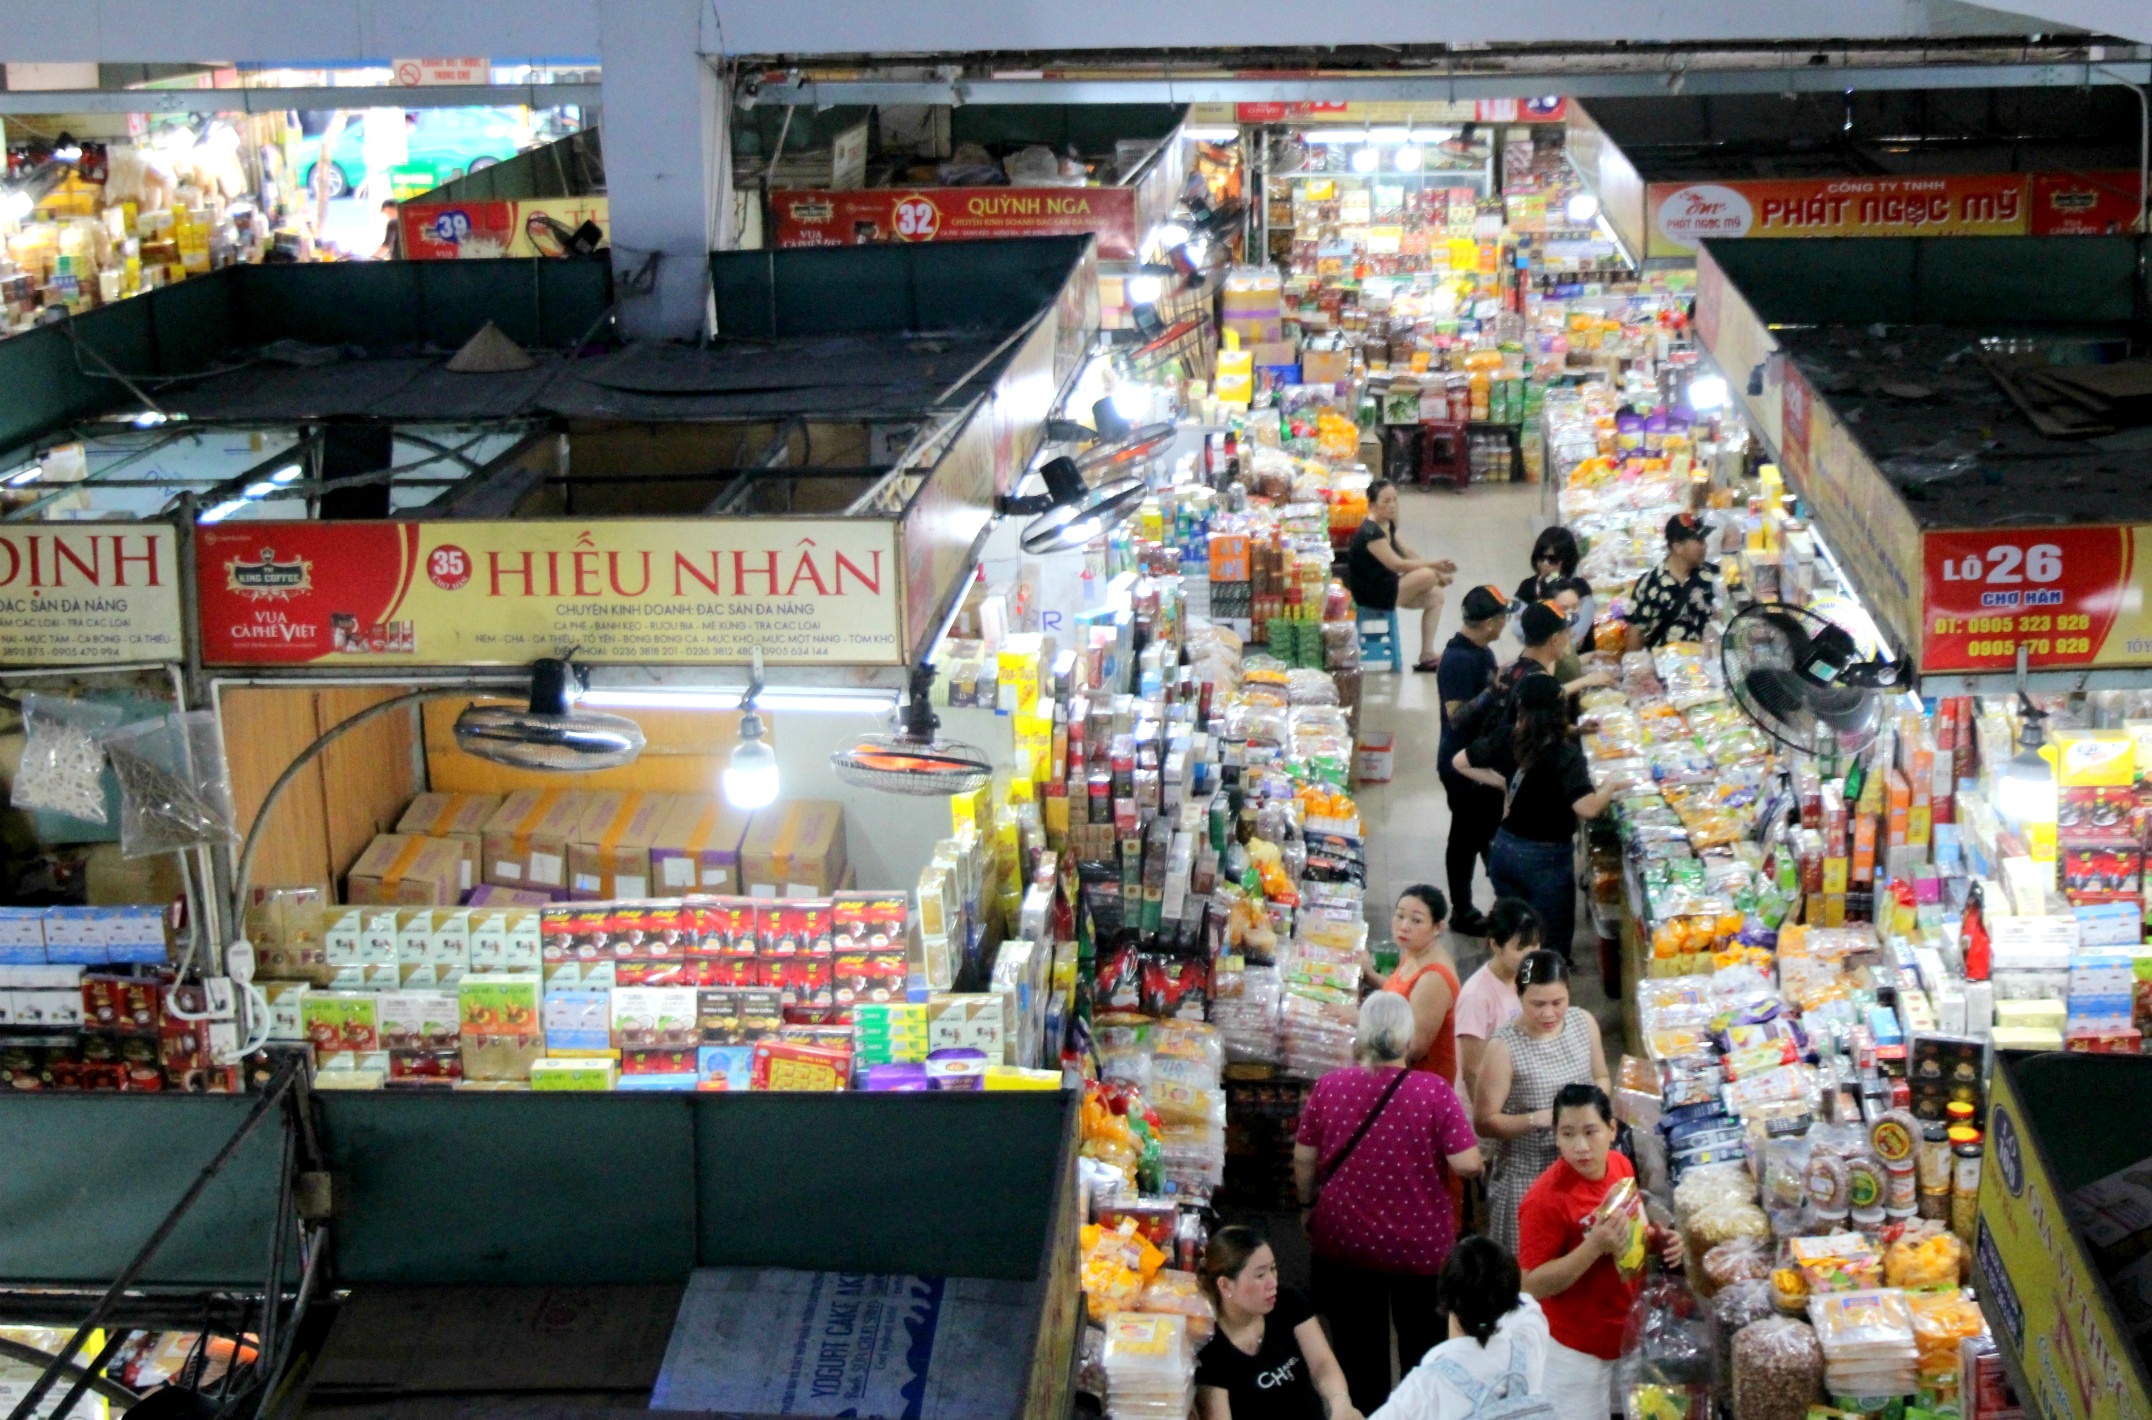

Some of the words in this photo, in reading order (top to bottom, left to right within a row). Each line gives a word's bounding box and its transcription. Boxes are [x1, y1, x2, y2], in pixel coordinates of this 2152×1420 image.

[1879, 182, 1898, 193] TY
[1903, 181, 1946, 191] TNHH
[968, 194, 1040, 217] QUỲNH
[1047, 198, 1091, 215] NGA
[1762, 192, 1851, 229] PHÁT
[1860, 195, 1950, 231] NGỌC
[438, 214, 468, 239] 39
[899, 203, 935, 235] 32
[433, 551, 464, 575] 35
[671, 536, 885, 597] NHÂN
[1943, 554, 1983, 581] LÔ
[1985, 543, 2063, 584] 26
[239, 574, 262, 583] KING
[264, 574, 300, 583] COFFEE
[556, 603, 608, 616] CHUYÊN
[611, 604, 641, 616] KINH
[696, 603, 724, 617] ĐẶC
[1980, 589, 2021, 609] CHỢ
[255, 611, 287, 624] VUA
[1042, 611, 1062, 632] R
[1967, 616, 2014, 633] 0905
[2018, 615, 2051, 631] 323
[1967, 640, 2015, 656] 0905
[2018, 638, 2050, 655] 70
[825, 1301, 859, 1337] CAKE
[810, 1340, 852, 1398] YOGURT
